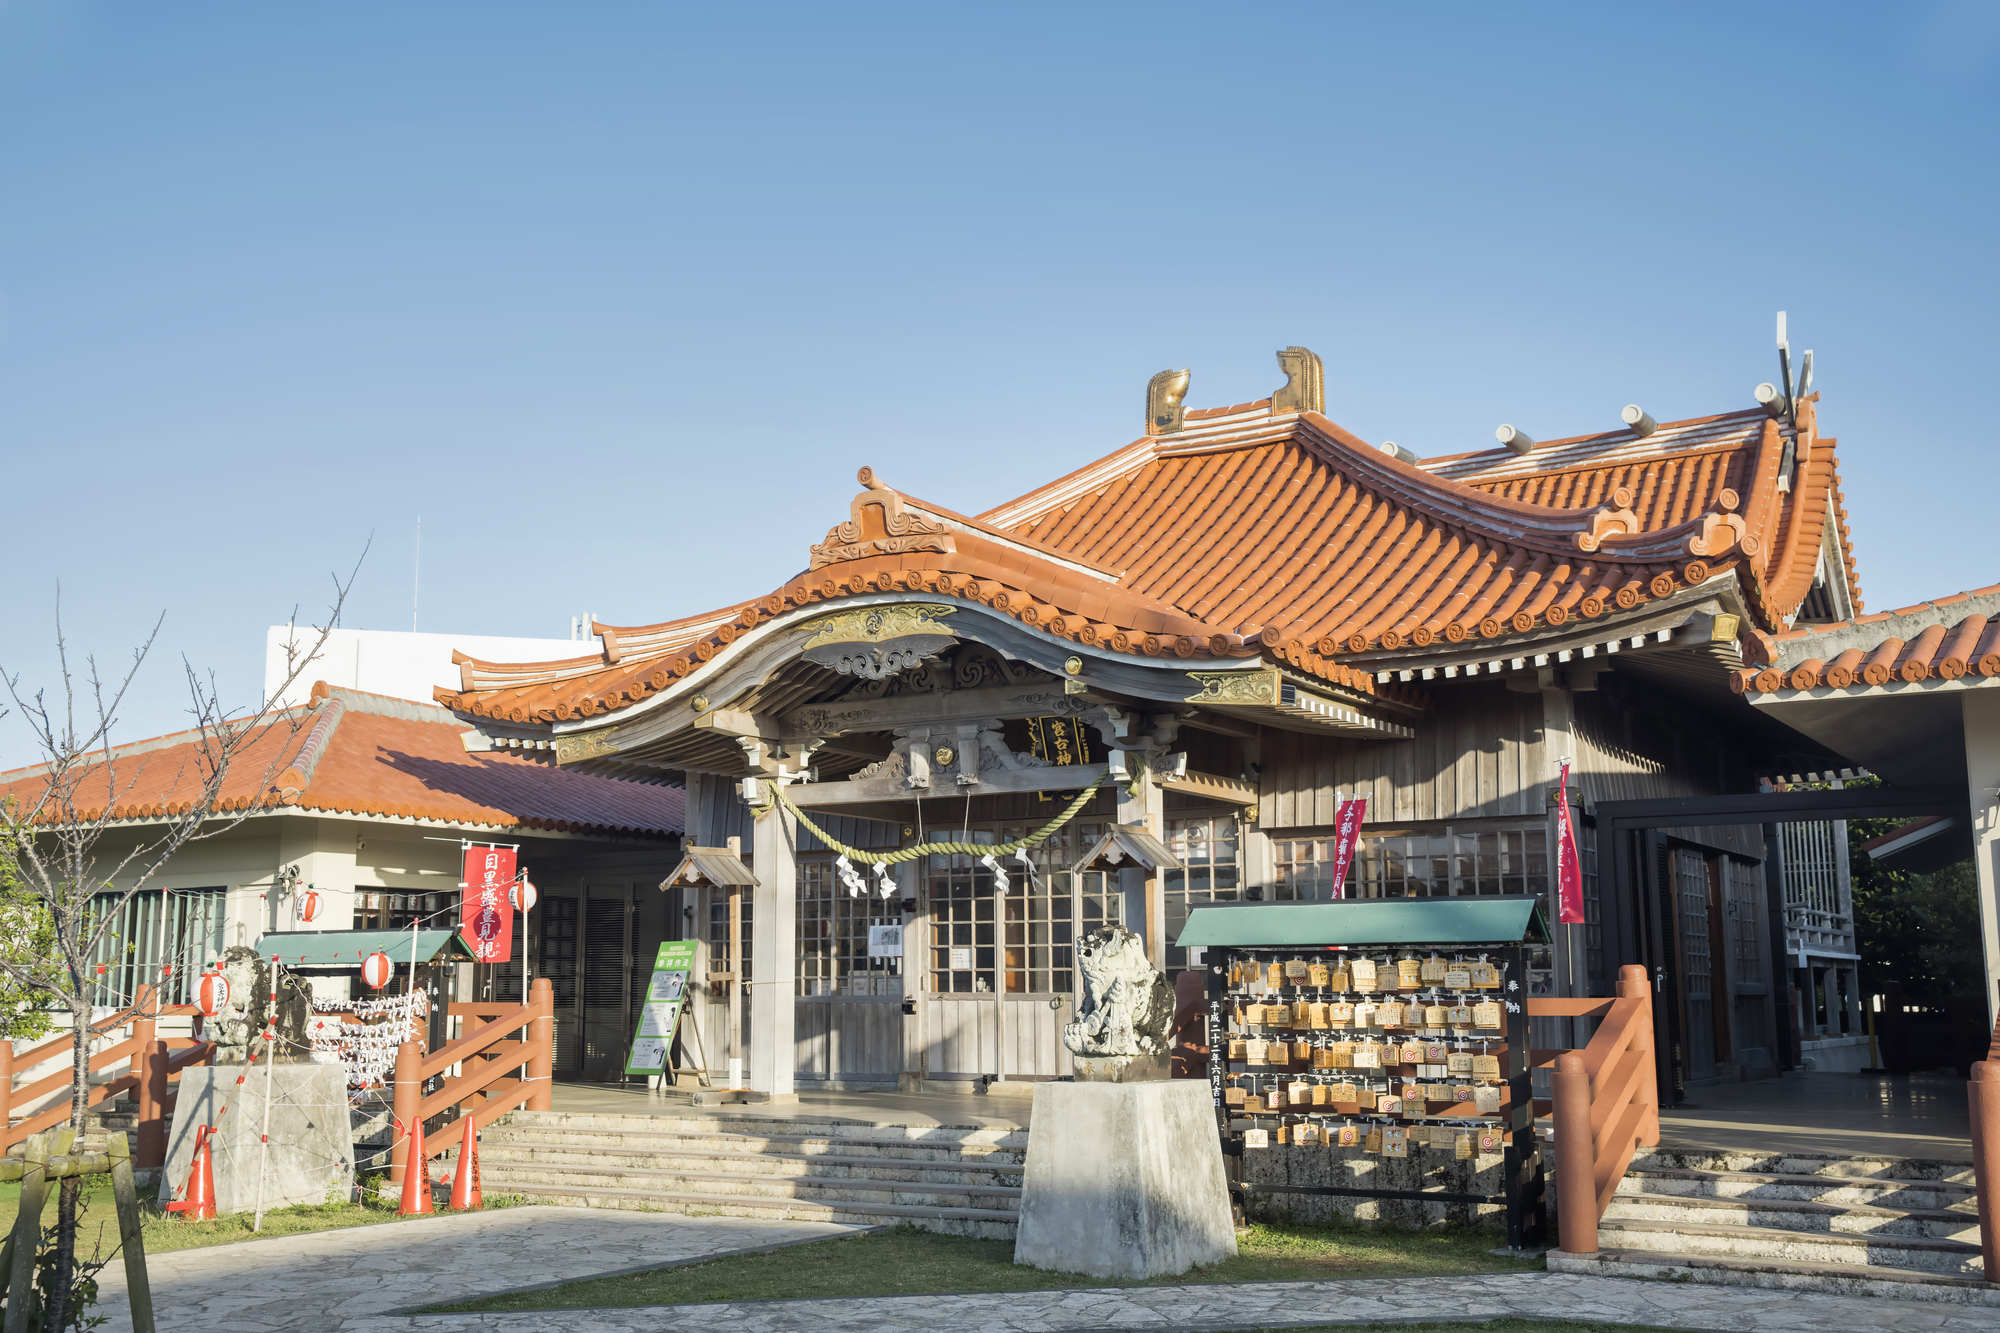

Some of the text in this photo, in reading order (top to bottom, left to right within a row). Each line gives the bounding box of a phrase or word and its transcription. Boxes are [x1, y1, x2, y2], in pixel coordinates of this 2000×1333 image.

[475, 853, 500, 958] 目黒盛豊見親
[1082, 1060, 1116, 1077] 奉納
[1210, 1001, 1222, 1108] 平成二十二年六月吉日
